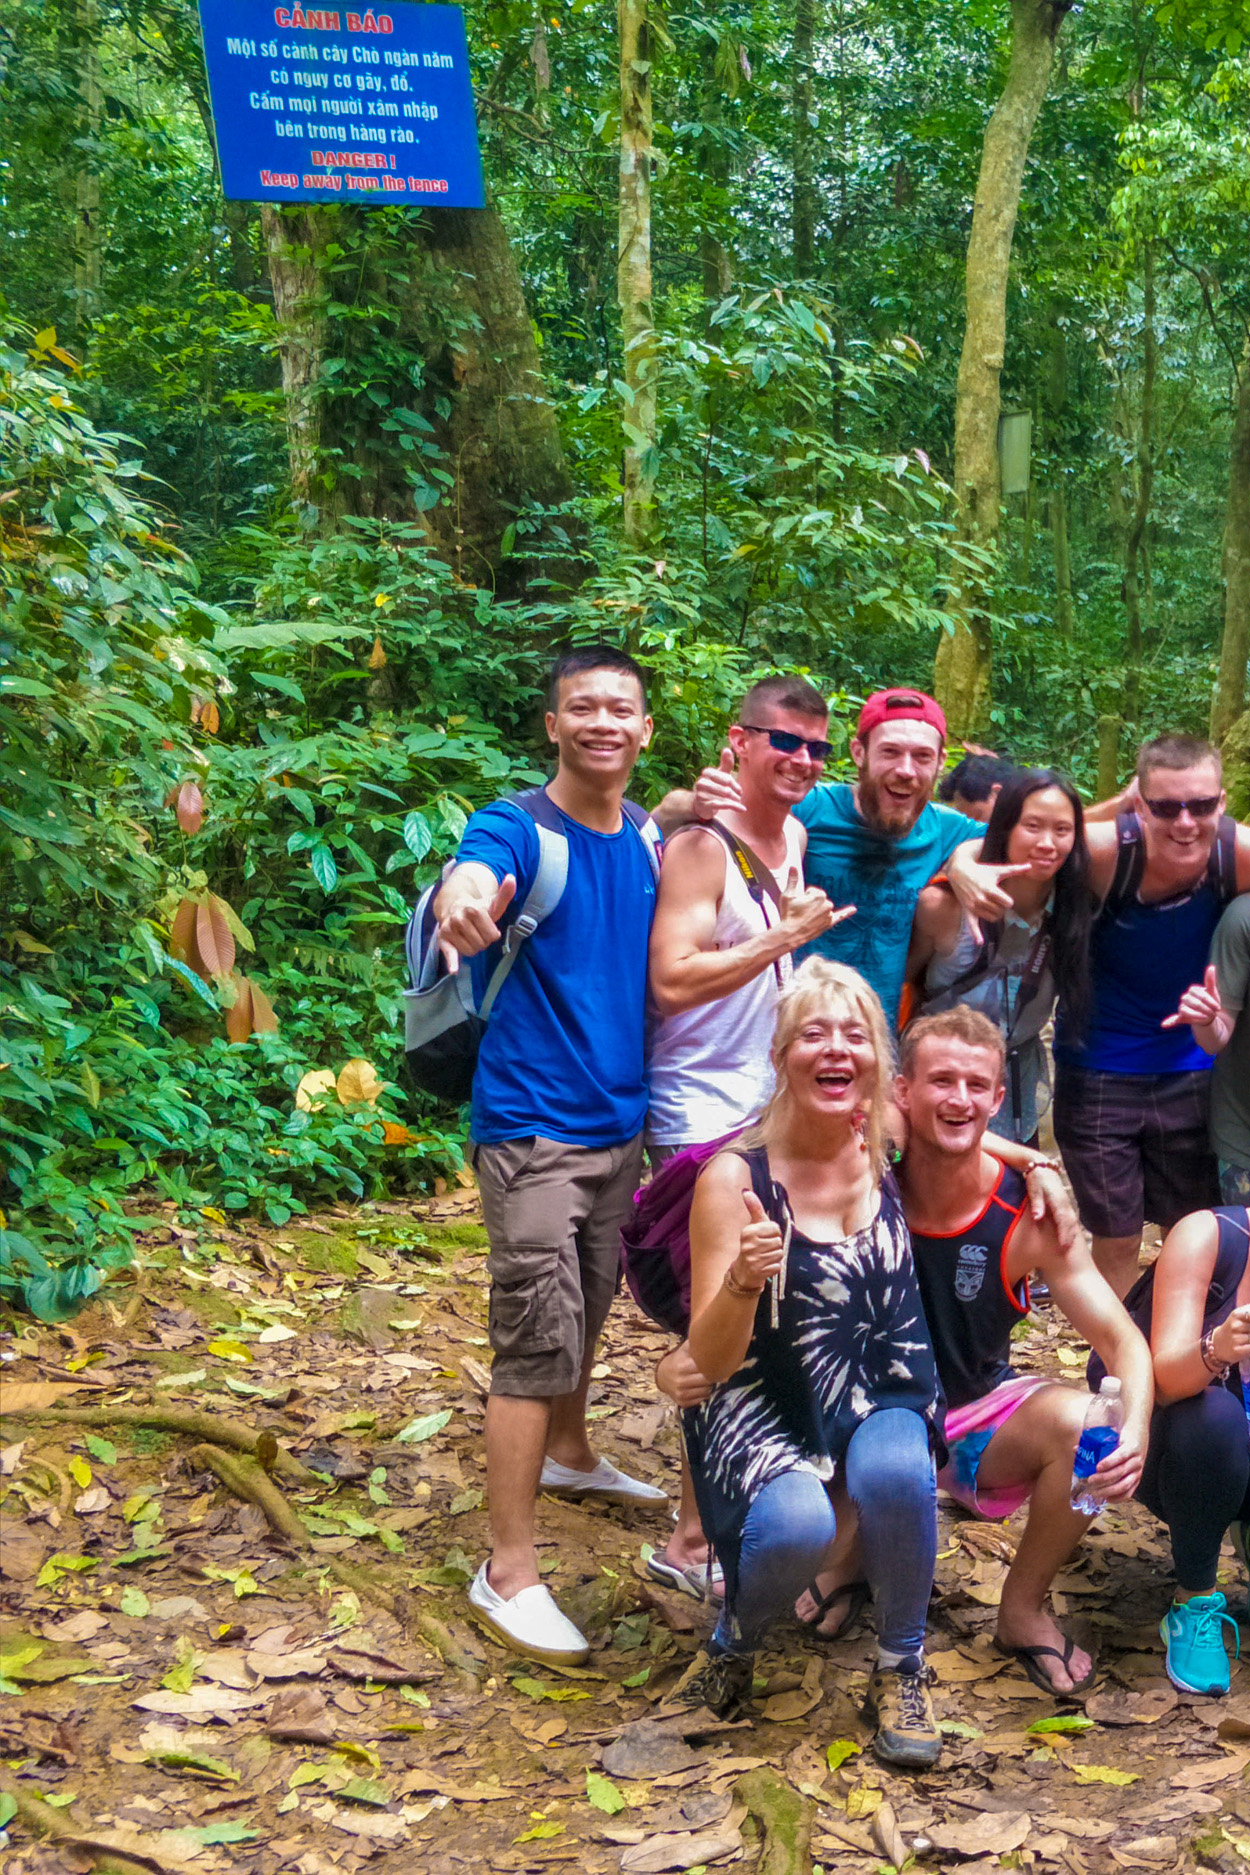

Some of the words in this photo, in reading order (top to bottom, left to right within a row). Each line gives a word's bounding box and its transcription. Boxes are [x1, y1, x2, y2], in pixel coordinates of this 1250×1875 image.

[274, 1, 340, 31] CẢNH
[346, 9, 393, 34] BÁO
[226, 37, 257, 58] Một
[260, 38, 278, 58] số
[282, 41, 319, 60] cành
[322, 44, 347, 64] cây
[352, 46, 379, 64] Chò
[384, 48, 419, 67] ngàn
[423, 51, 454, 69] năm
[270, 66, 289, 85] có
[293, 71, 328, 89] nguy
[334, 73, 352, 88] cơ
[356, 72, 387, 92] gãy,
[390, 70, 414, 92] đổ.
[249, 90, 284, 111] Cấm
[288, 95, 317, 115] mọi
[321, 96, 363, 116] người
[367, 98, 399, 117] xâm
[403, 101, 438, 121] nhập
[275, 119, 304, 137] bên
[307, 122, 347, 142] trong
[350, 123, 387, 144] hàng
[390, 125, 420, 144] rào.
[260, 169, 299, 189] Keep
[303, 174, 342, 191] away
[345, 174, 379, 190] from
[382, 175, 406, 191] the
[408, 176, 449, 193] fence
